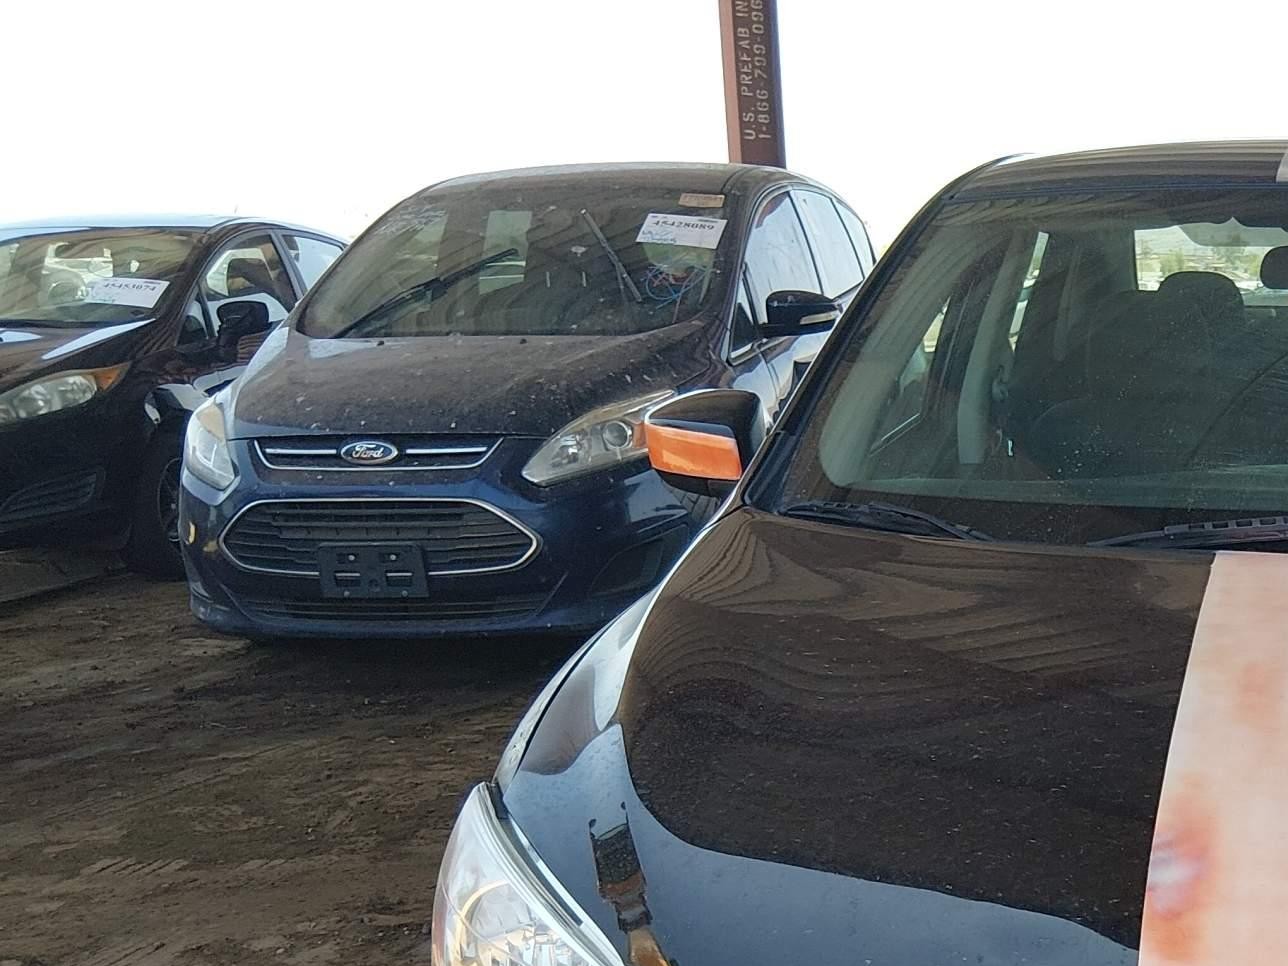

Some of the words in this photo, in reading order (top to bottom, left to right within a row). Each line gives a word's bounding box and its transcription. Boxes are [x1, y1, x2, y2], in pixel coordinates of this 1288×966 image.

[737, 27, 753, 96] PREFAB
[743, 107, 757, 140] U.S.
[352, 444, 384, 458] Ford
